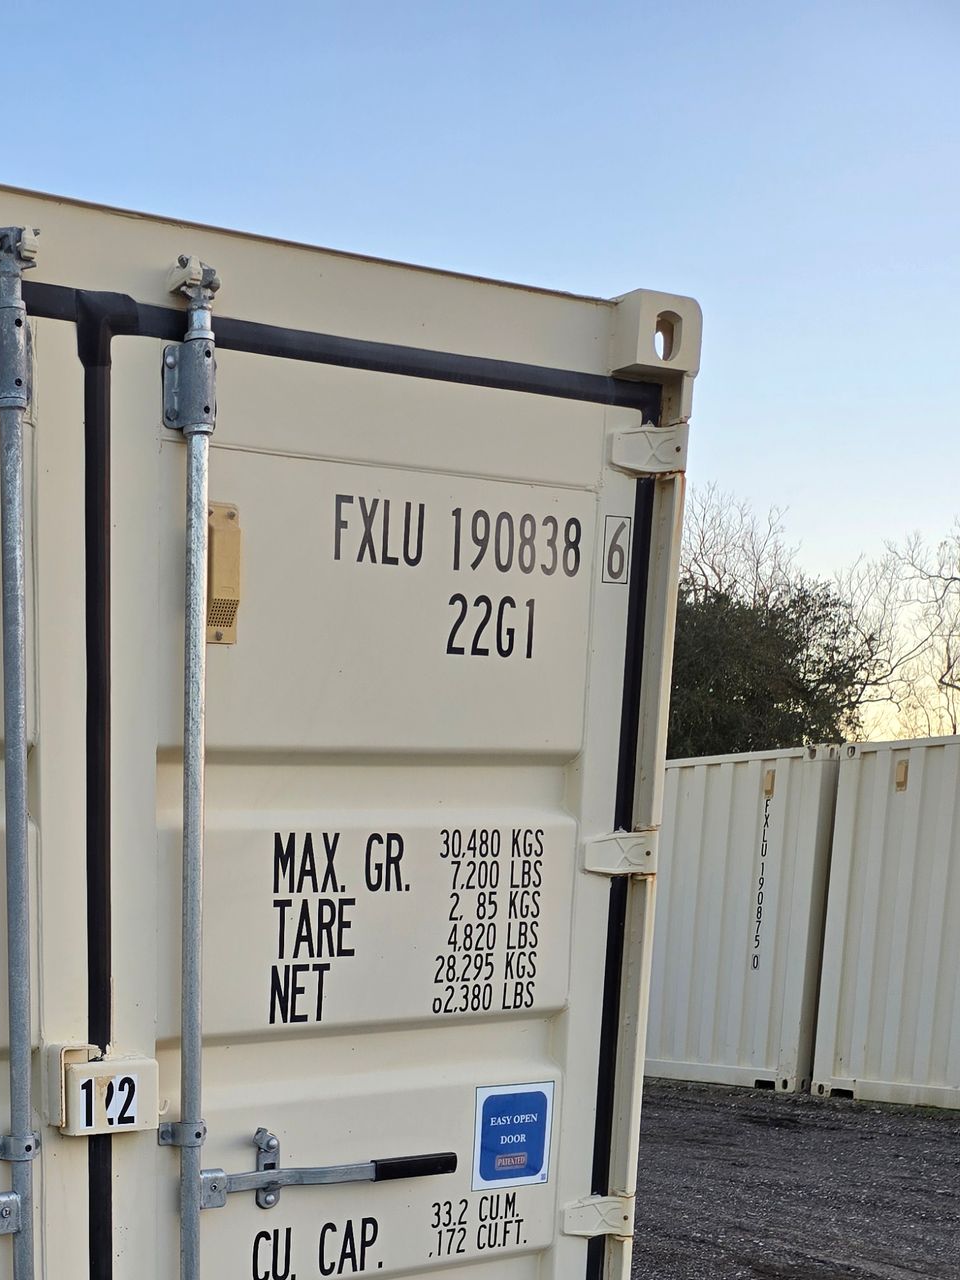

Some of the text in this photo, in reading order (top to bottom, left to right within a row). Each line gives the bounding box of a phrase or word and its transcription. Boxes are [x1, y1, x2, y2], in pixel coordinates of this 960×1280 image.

[334, 494, 627, 580] FXLU 190838 6
[446, 593, 535, 659] 22G1
[440, 829, 544, 858] 30,480 KGS
[761, 799, 771, 857] FXLU
[273, 832, 410, 893] MAX. GR.
[510, 860, 542, 888] LBS
[508, 890, 541, 919] KGS
[754, 862, 765, 949] 190875
[273, 898, 356, 959] TARE
[447, 921, 539, 952] 4,820 LBS
[434, 950, 537, 983] 28,295 KGS
[269, 963, 330, 1024] NET
[501, 981, 535, 1011] LBS
[490, 1113, 538, 1126] EASY OPEN
[500, 1134, 527, 1145] DOOR
[497, 1156, 525, 1167] PATENTED
[431, 1192, 520, 1229] 33.2 CU.M.
[318, 1216, 384, 1276] CAP.
[477, 1219, 527, 1250] CU.FT.
